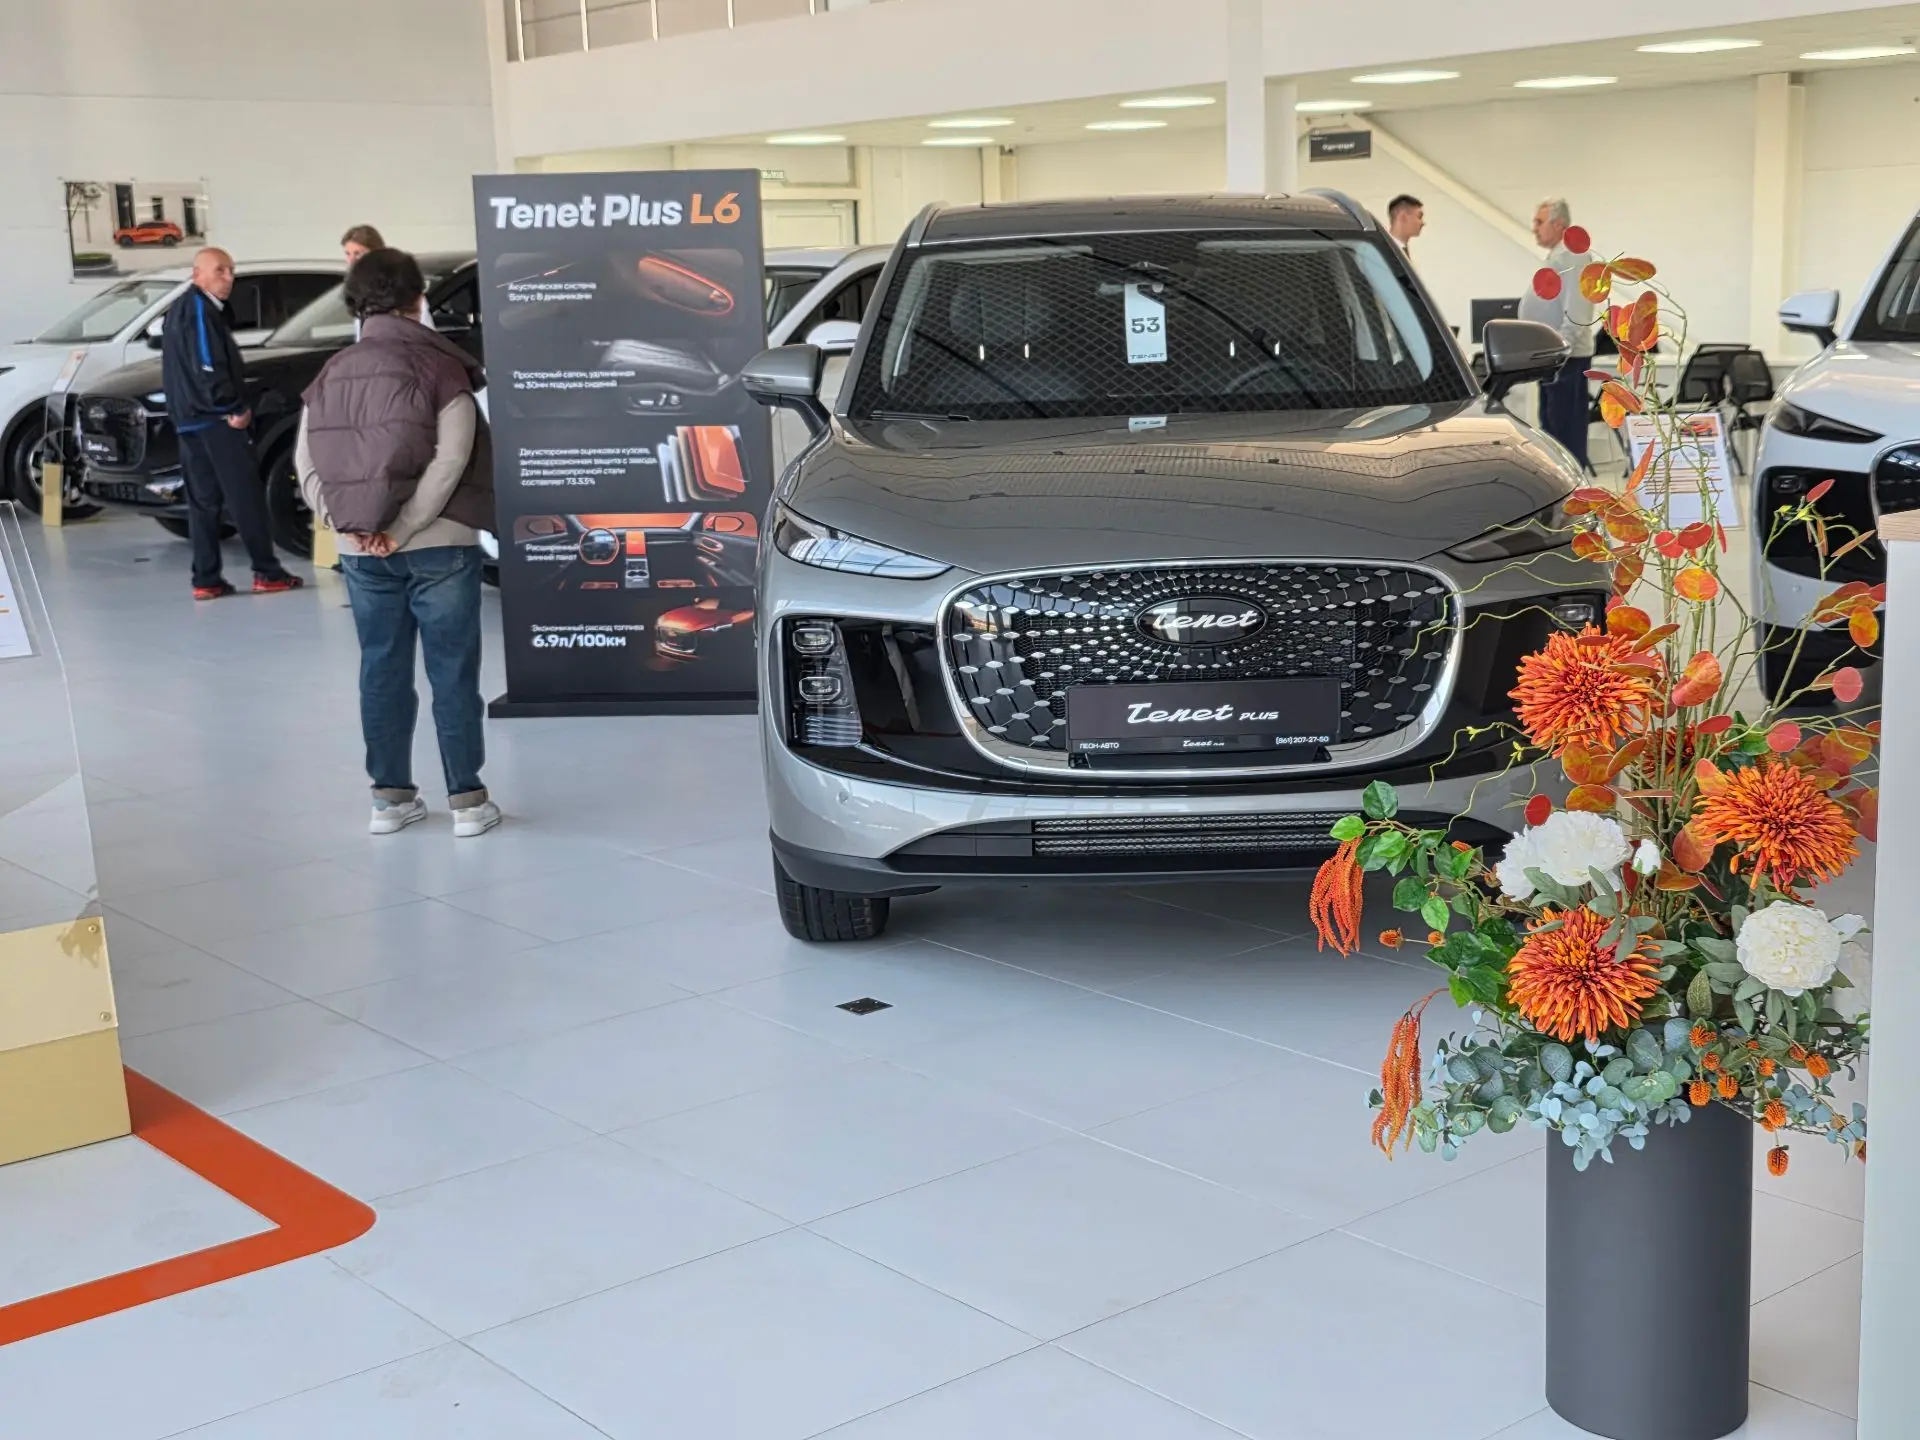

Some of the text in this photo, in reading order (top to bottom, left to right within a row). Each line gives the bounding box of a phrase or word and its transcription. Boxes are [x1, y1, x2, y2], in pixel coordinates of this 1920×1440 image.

[490, 192, 741, 229] Tenet Plus L6
[1131, 317, 1161, 333] 53
[1152, 607, 1259, 629] Tenet
[532, 633, 626, 648] 6.9л/100км
[1127, 702, 1279, 725] Tenet PLUS
